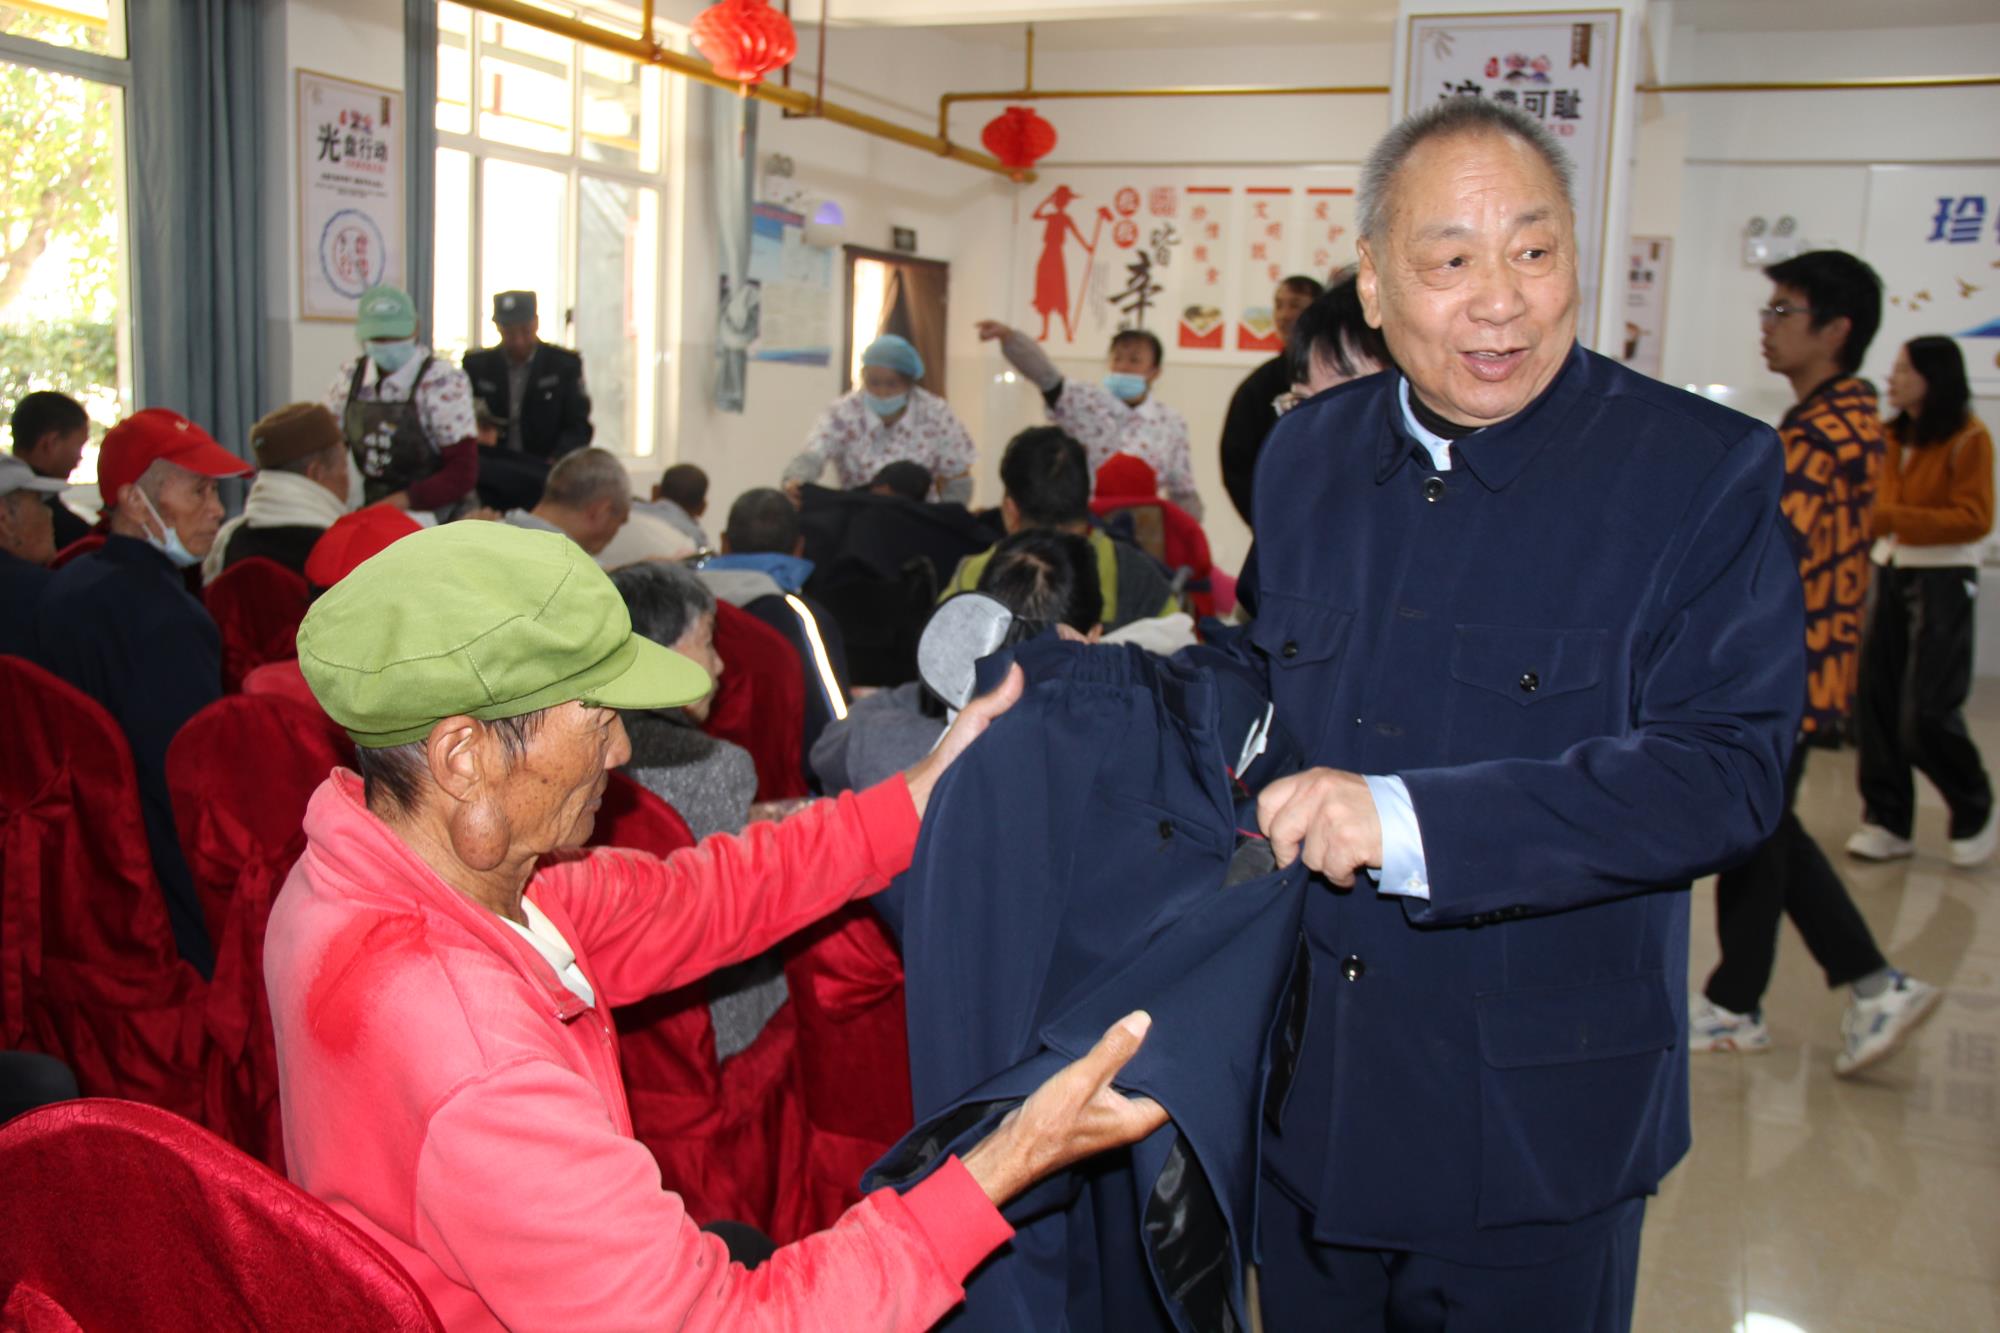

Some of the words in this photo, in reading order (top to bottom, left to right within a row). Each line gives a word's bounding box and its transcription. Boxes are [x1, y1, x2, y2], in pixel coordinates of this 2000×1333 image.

[317, 123, 388, 162] 光盘行动
[1926, 195, 2000, 244] 珍
